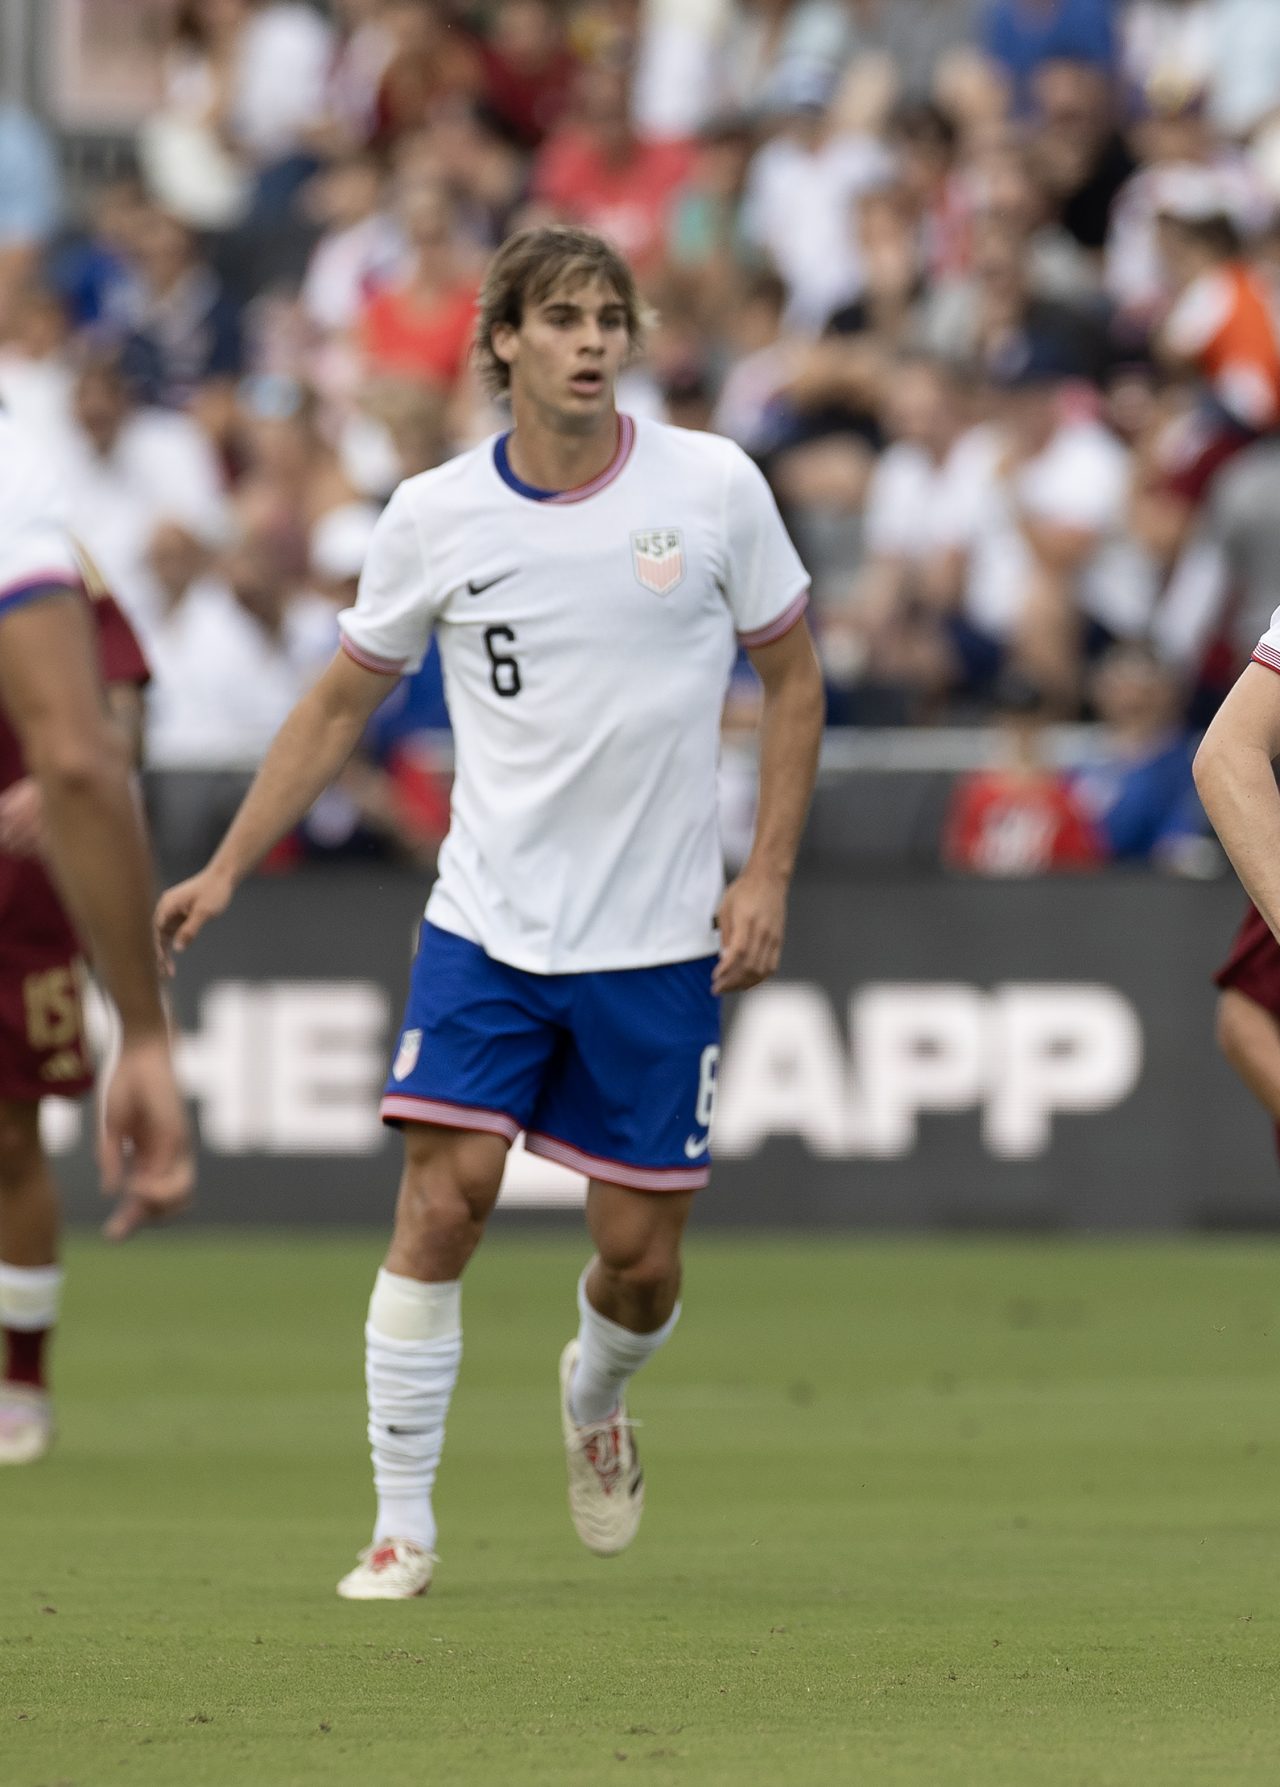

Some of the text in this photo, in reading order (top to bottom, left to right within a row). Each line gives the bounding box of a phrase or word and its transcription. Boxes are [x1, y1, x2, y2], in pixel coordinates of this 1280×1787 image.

[635, 532, 680, 558] USA
[484, 625, 521, 697] 6
[708, 980, 1145, 1160] APP
